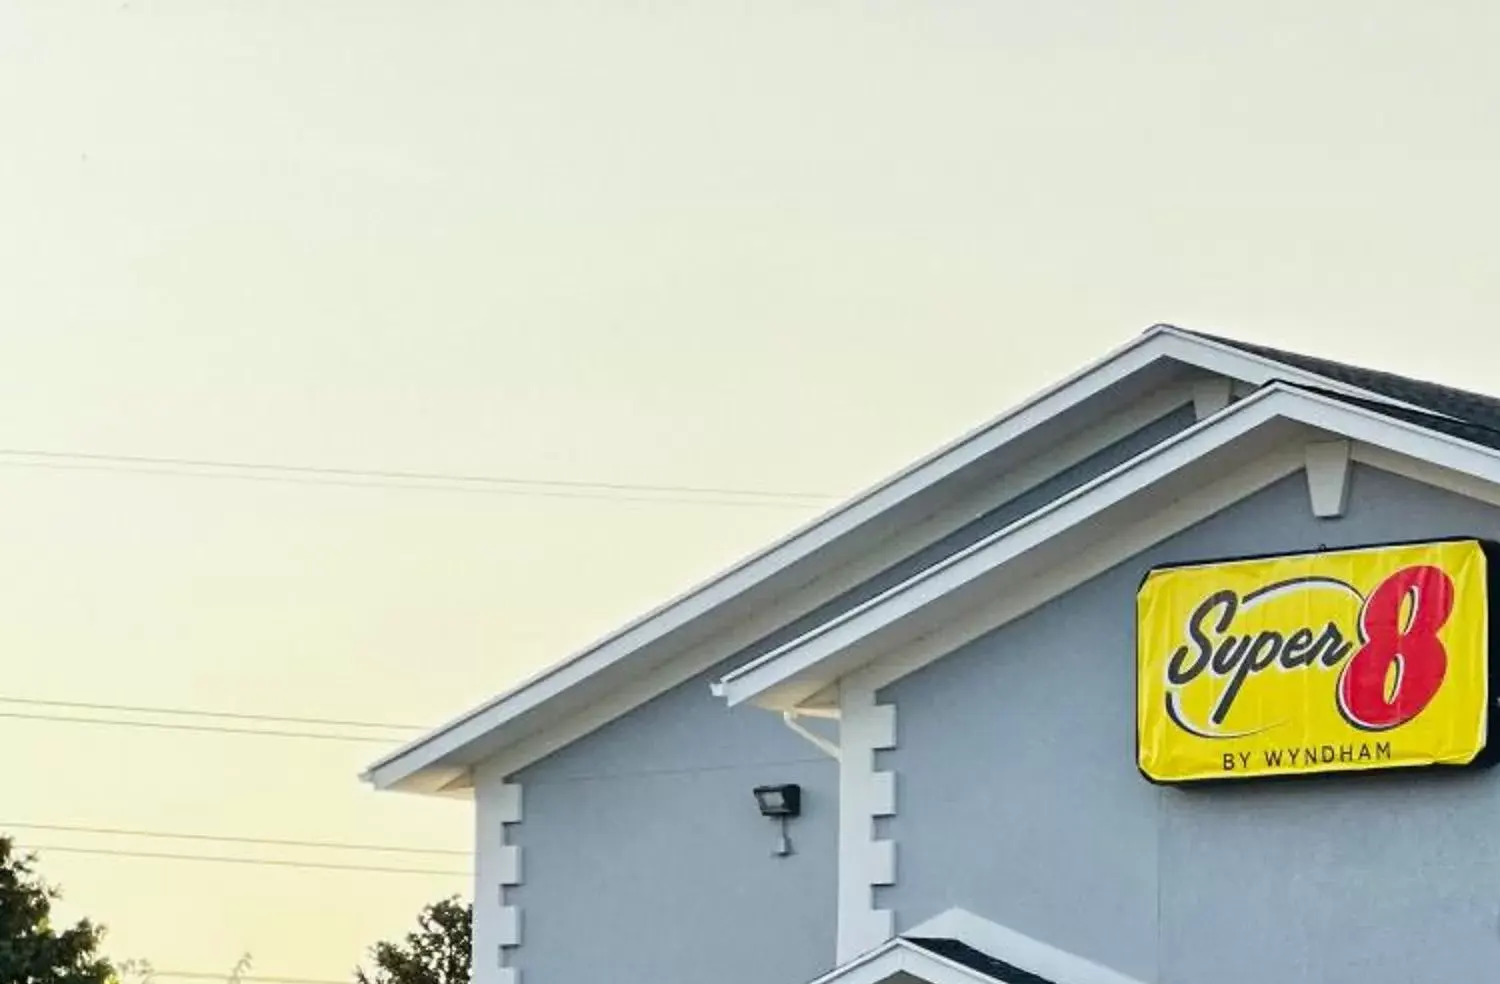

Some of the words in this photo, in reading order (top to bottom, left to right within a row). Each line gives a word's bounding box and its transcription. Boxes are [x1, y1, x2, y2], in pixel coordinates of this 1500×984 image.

[1168, 589, 1353, 725] Super
[1336, 564, 1455, 731] 8
[1222, 752, 1251, 771] BY
[1264, 741, 1392, 767] WYNDHAM
